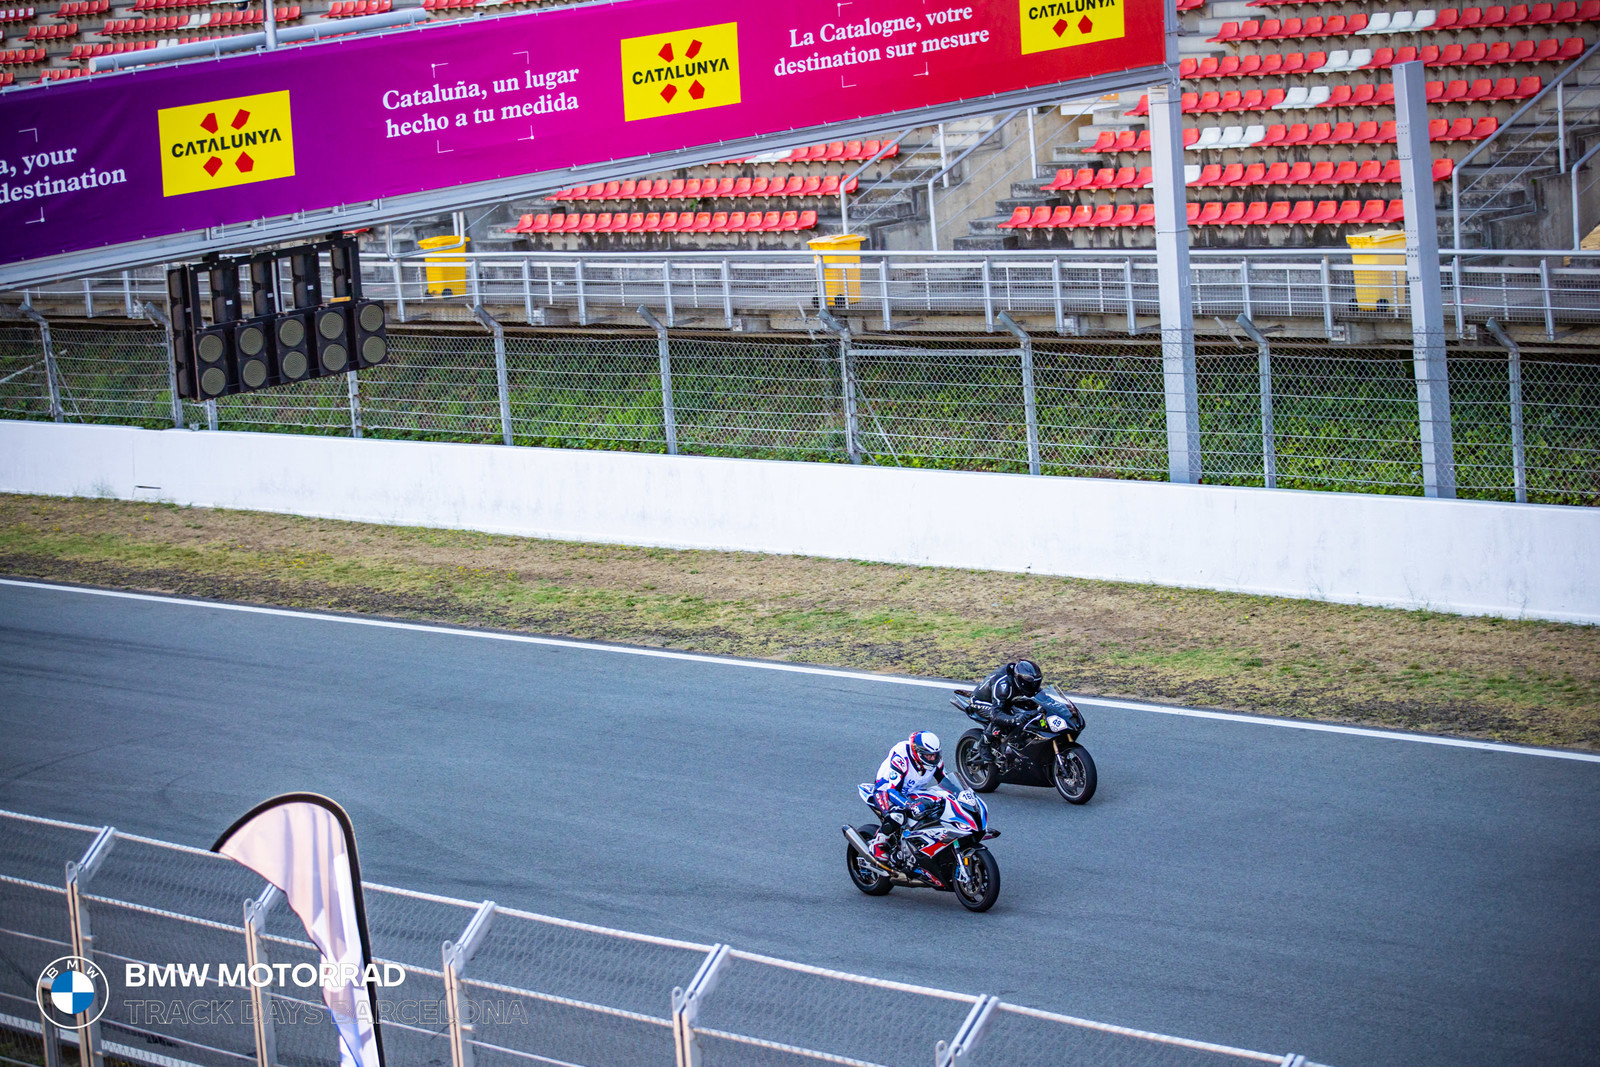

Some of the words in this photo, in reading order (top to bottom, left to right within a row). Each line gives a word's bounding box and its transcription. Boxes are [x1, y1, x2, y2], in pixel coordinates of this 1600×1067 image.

[789, 29, 814, 48] La
[819, 16, 922, 43] Catalogne,
[926, 6, 973, 26] votre
[632, 57, 730, 85] CATALUNYA
[774, 46, 881, 77] destination
[886, 41, 917, 59] sur
[921, 29, 990, 53] mesure
[382, 80, 488, 110] Cataluña,
[492, 77, 520, 94] un
[525, 68, 579, 90] lugar
[385, 112, 449, 138] hecho
[455, 112, 468, 127] a
[474, 107, 495, 124] tu
[500, 92, 579, 120] medida
[22, 147, 77, 175] your
[171, 128, 282, 158] CATALUNYA
[0, 167, 127, 204] destination
